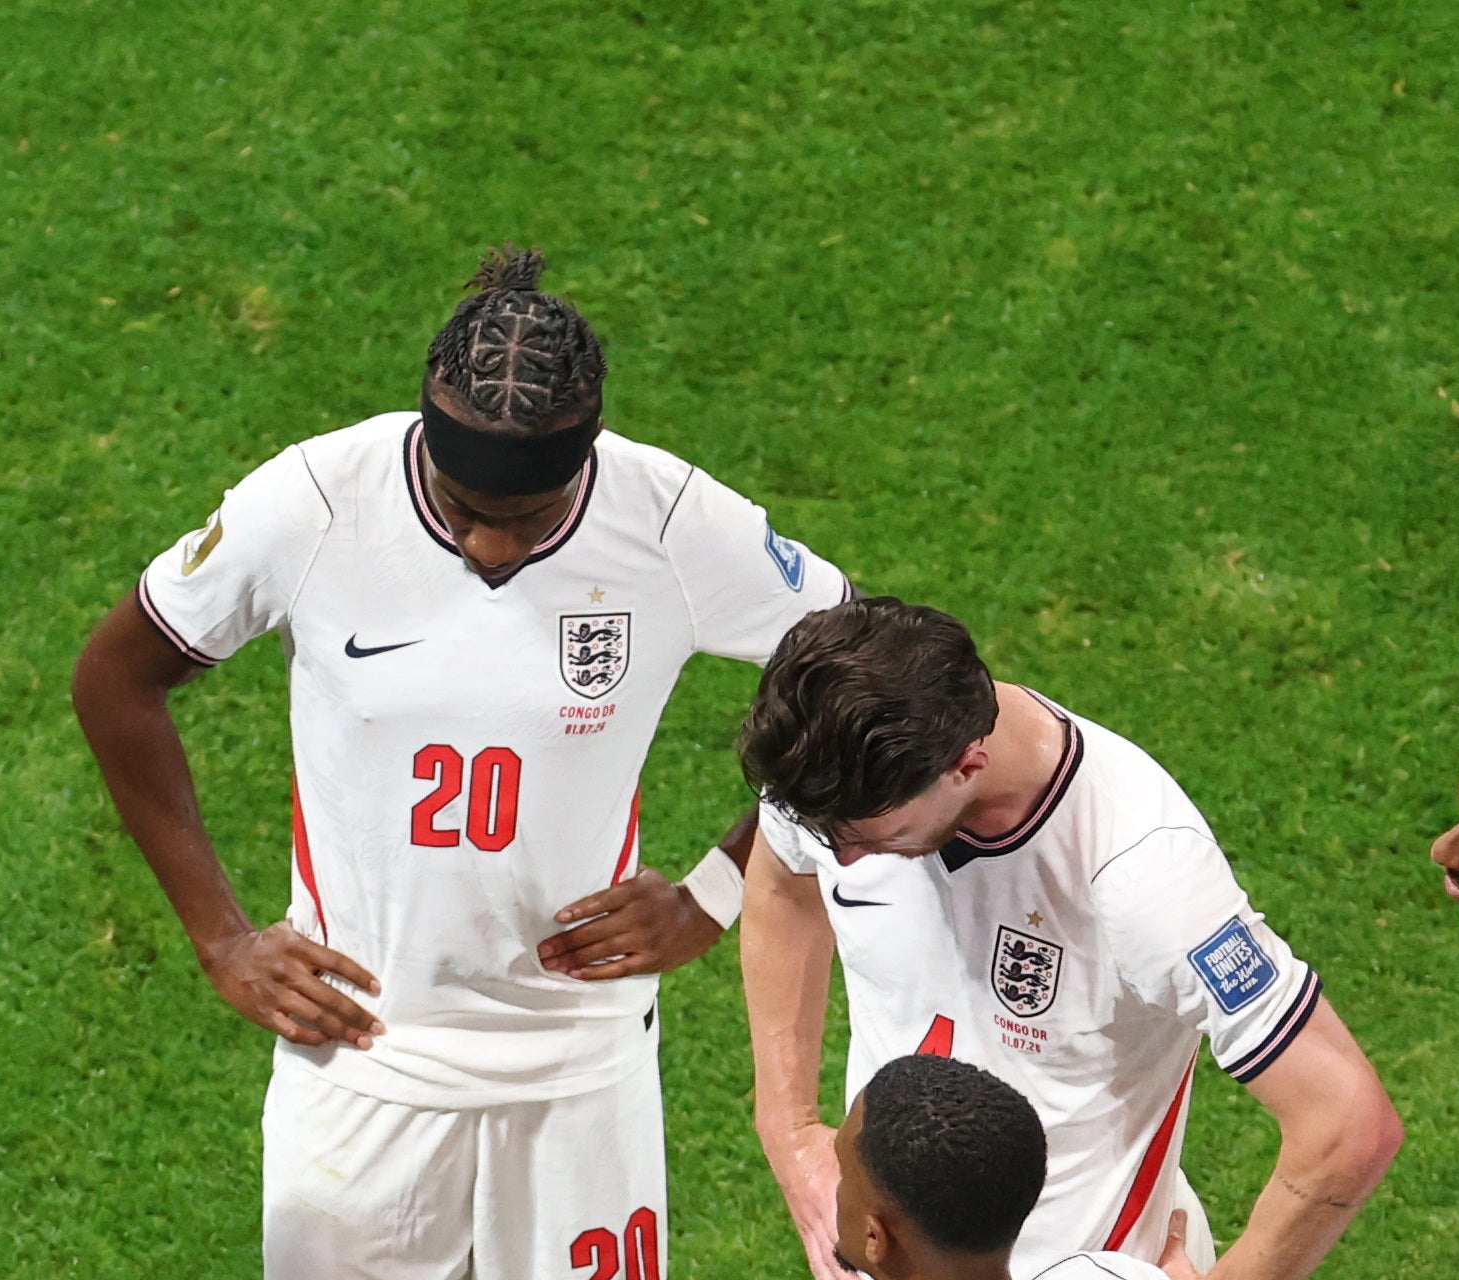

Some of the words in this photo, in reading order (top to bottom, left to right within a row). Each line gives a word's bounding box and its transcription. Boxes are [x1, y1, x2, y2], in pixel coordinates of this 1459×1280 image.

[560, 705, 600, 719] CONGO
[602, 704, 616, 717] DR
[410, 743, 522, 853] 20
[1204, 932, 1244, 968] FOOTBALL
[1211, 941, 1253, 980] UNITES
[993, 1013, 1030, 1036] CONGO
[1032, 1028, 1048, 1041] DR
